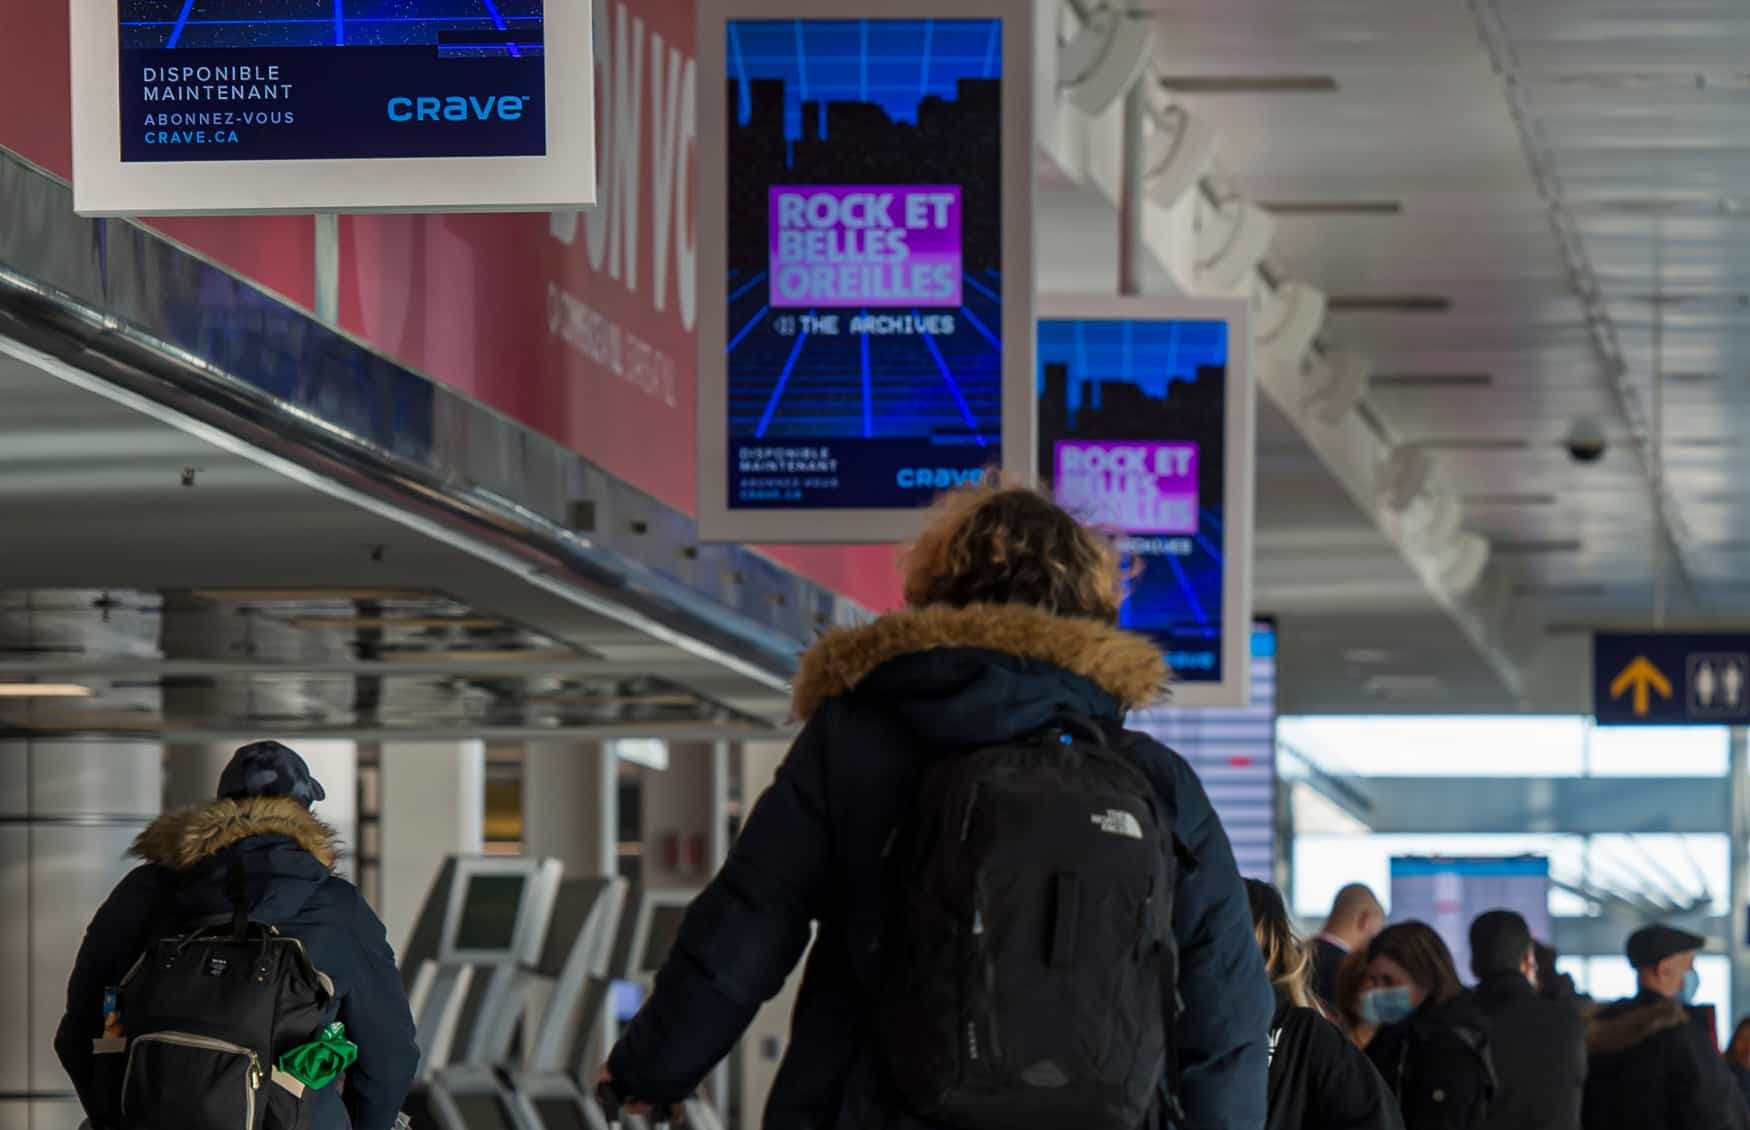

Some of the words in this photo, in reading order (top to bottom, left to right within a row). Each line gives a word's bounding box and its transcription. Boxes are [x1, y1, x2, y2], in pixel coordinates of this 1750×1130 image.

[143, 65, 280, 82] DISPONIBLE
[143, 84, 294, 101] MAINTENANT
[144, 111, 294, 126] ABONNEZ-VOUS
[144, 130, 239, 144] CRAVE.CA
[777, 192, 893, 228] ROCK
[905, 192, 956, 229] ET
[778, 229, 910, 262] BELLES
[778, 264, 956, 299] OREILLES
[799, 314, 840, 335] THE
[850, 314, 955, 335] ARCHIVES
[1060, 446, 1147, 472] ROCK
[1154, 446, 1195, 477] ET
